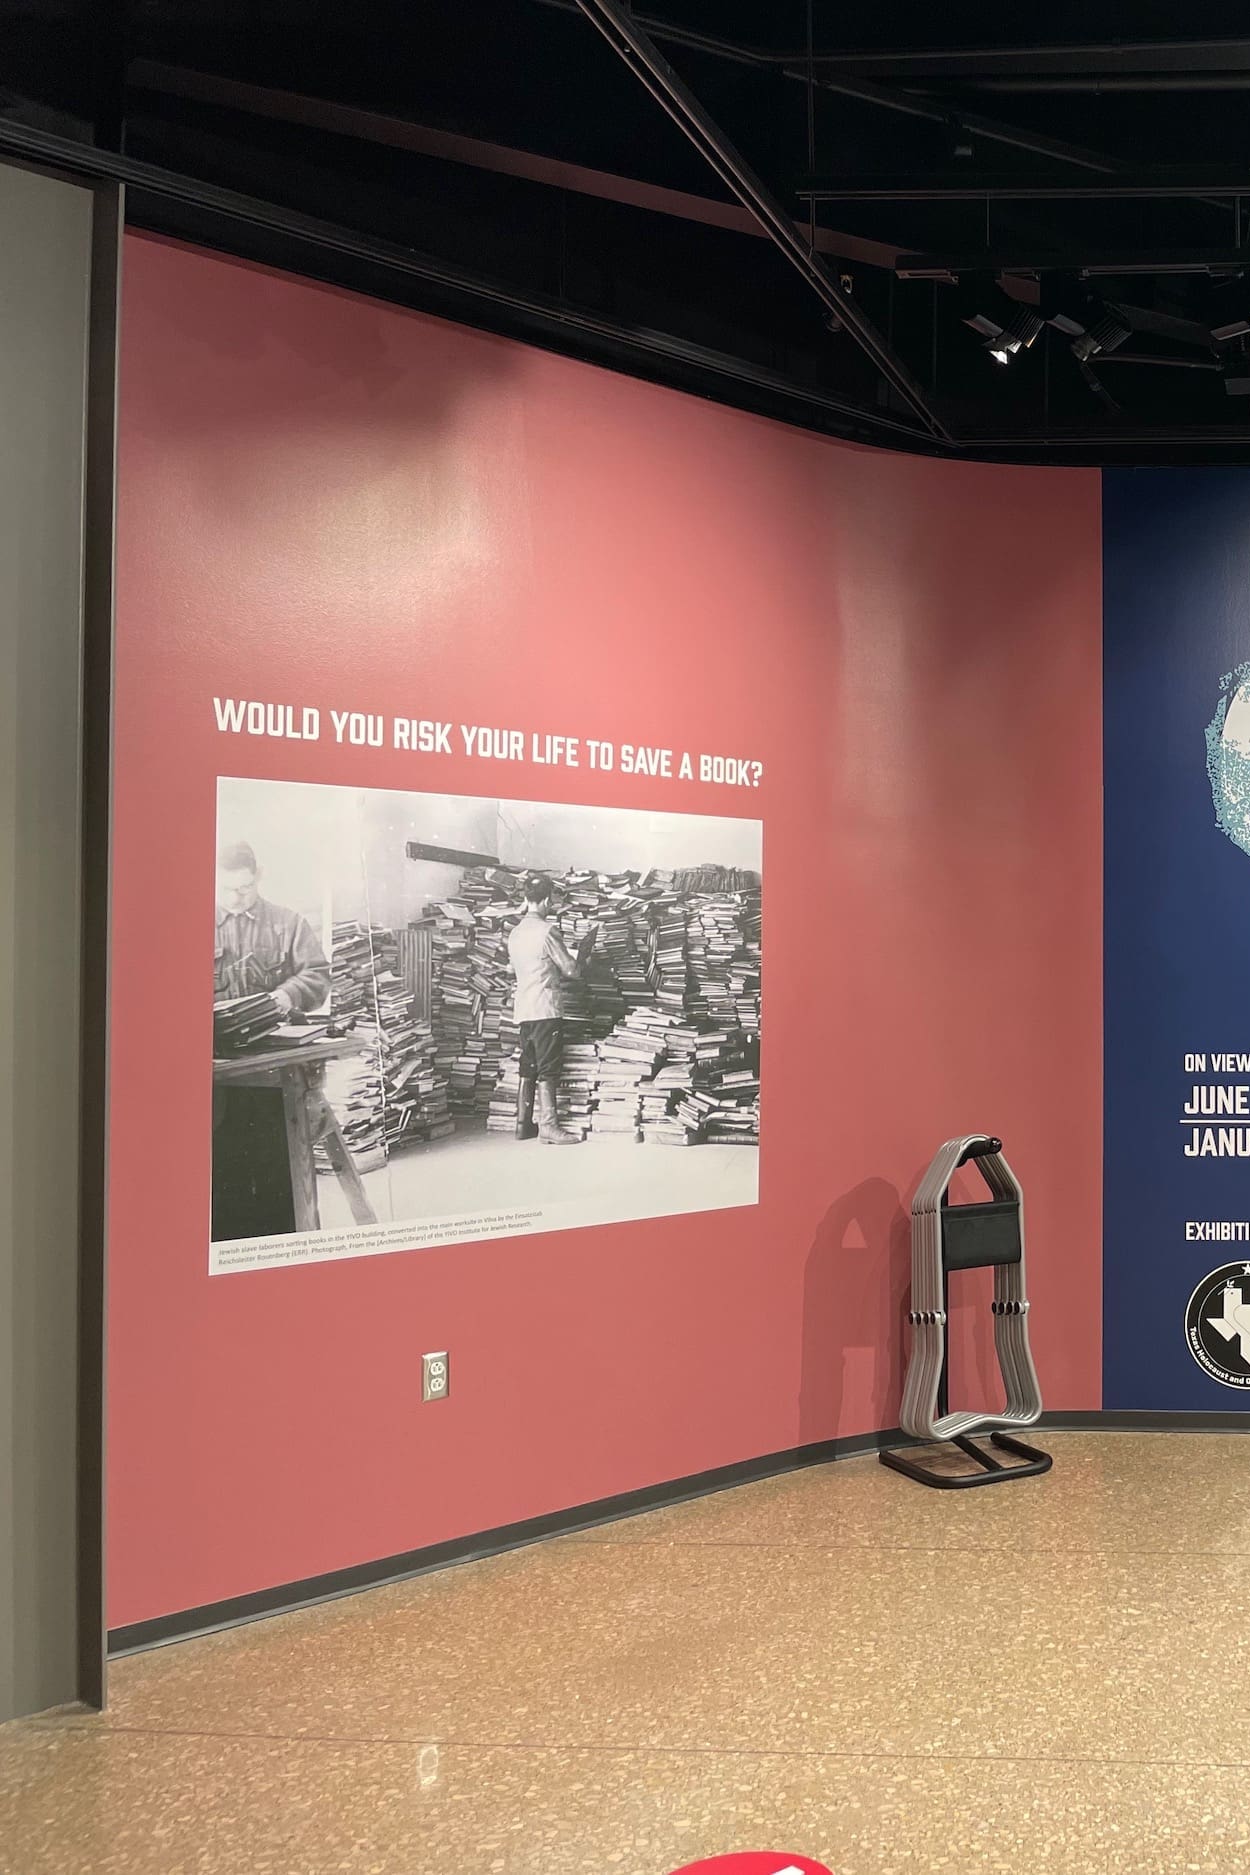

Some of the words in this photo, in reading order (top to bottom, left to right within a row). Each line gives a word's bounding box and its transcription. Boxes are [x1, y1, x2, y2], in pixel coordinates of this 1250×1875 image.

[214, 698, 319, 741] WOULD
[330, 710, 383, 747] YOU
[394, 718, 452, 754] RISK
[461, 724, 524, 760] YOUR
[531, 734, 579, 768] LIFE
[586, 740, 614, 770] TO
[620, 744, 672, 778] SAVE
[679, 752, 693, 780] A
[700, 755, 763, 788] BOOK?
[1184, 1053, 1206, 1072] ON
[1184, 1086, 1250, 1114] JUNE
[1190, 1326, 1198, 1350] Texas
[1197, 1350, 1228, 1380] Holocaust
[1229, 1374, 1244, 1384] and
